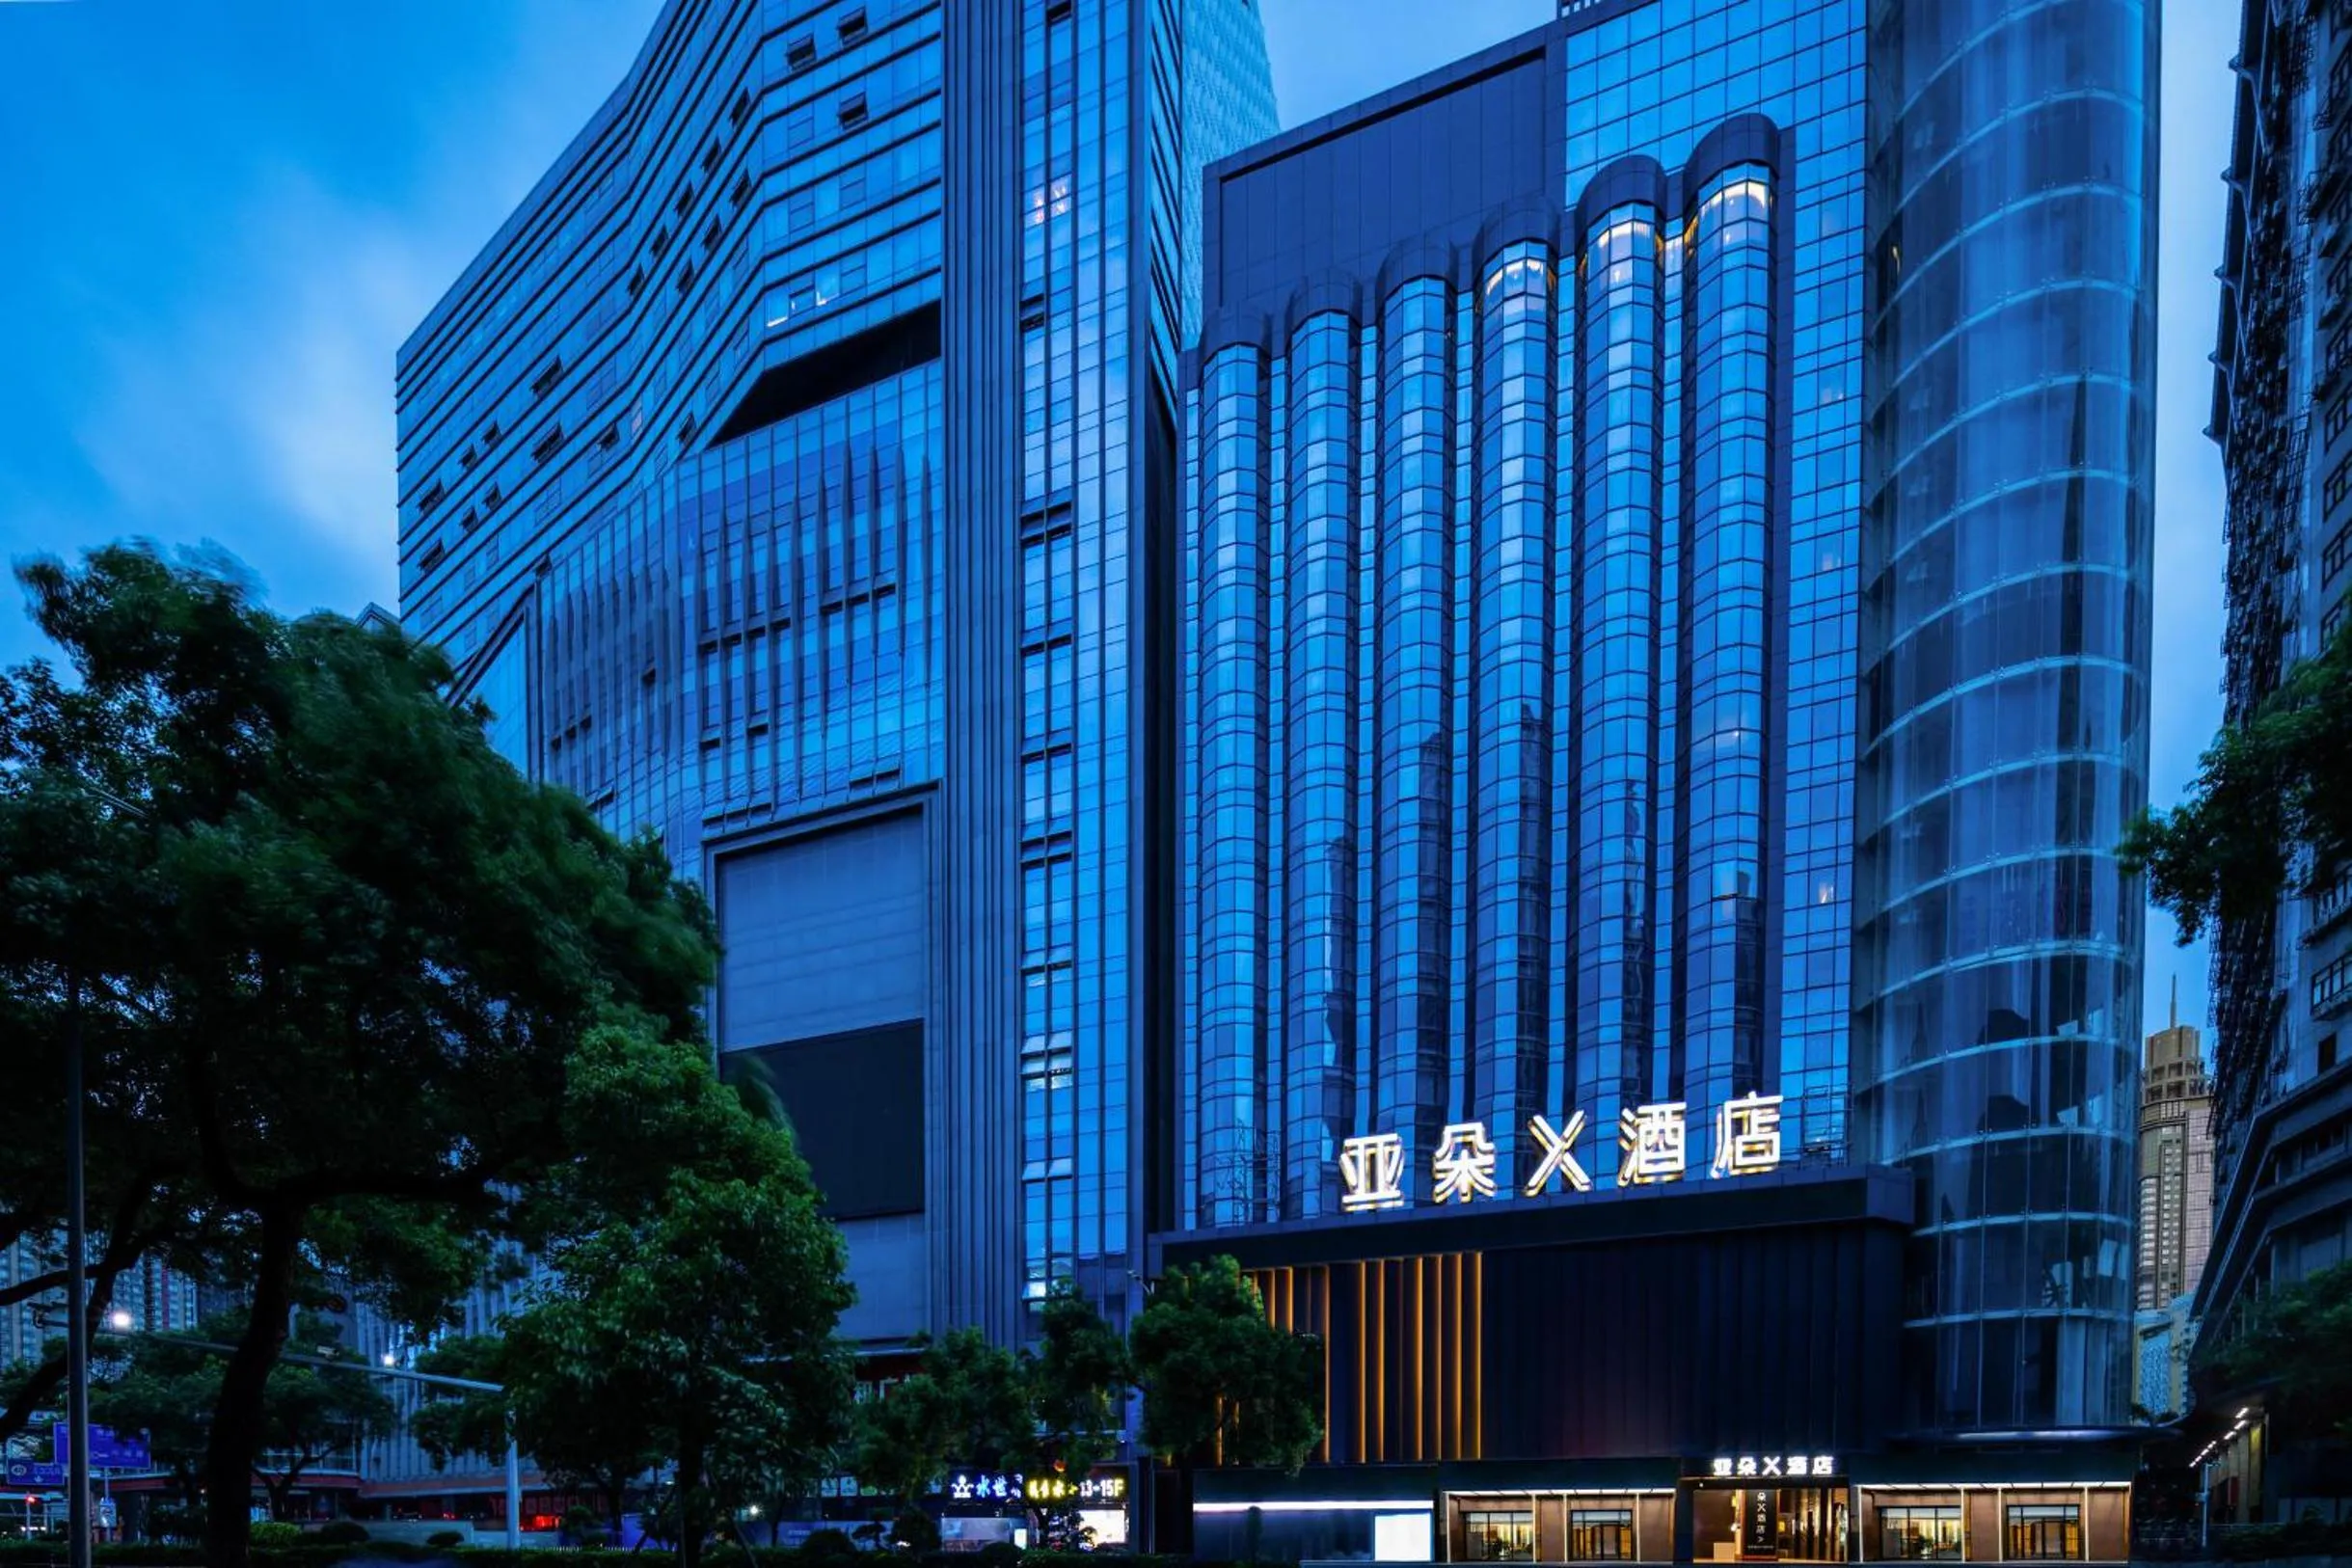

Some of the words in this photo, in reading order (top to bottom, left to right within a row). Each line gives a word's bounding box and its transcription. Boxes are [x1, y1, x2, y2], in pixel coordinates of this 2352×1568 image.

[1340, 1091, 1783, 1211] 亚朵X酒店
[1713, 1455, 1834, 1476] 亚朵X酒店
